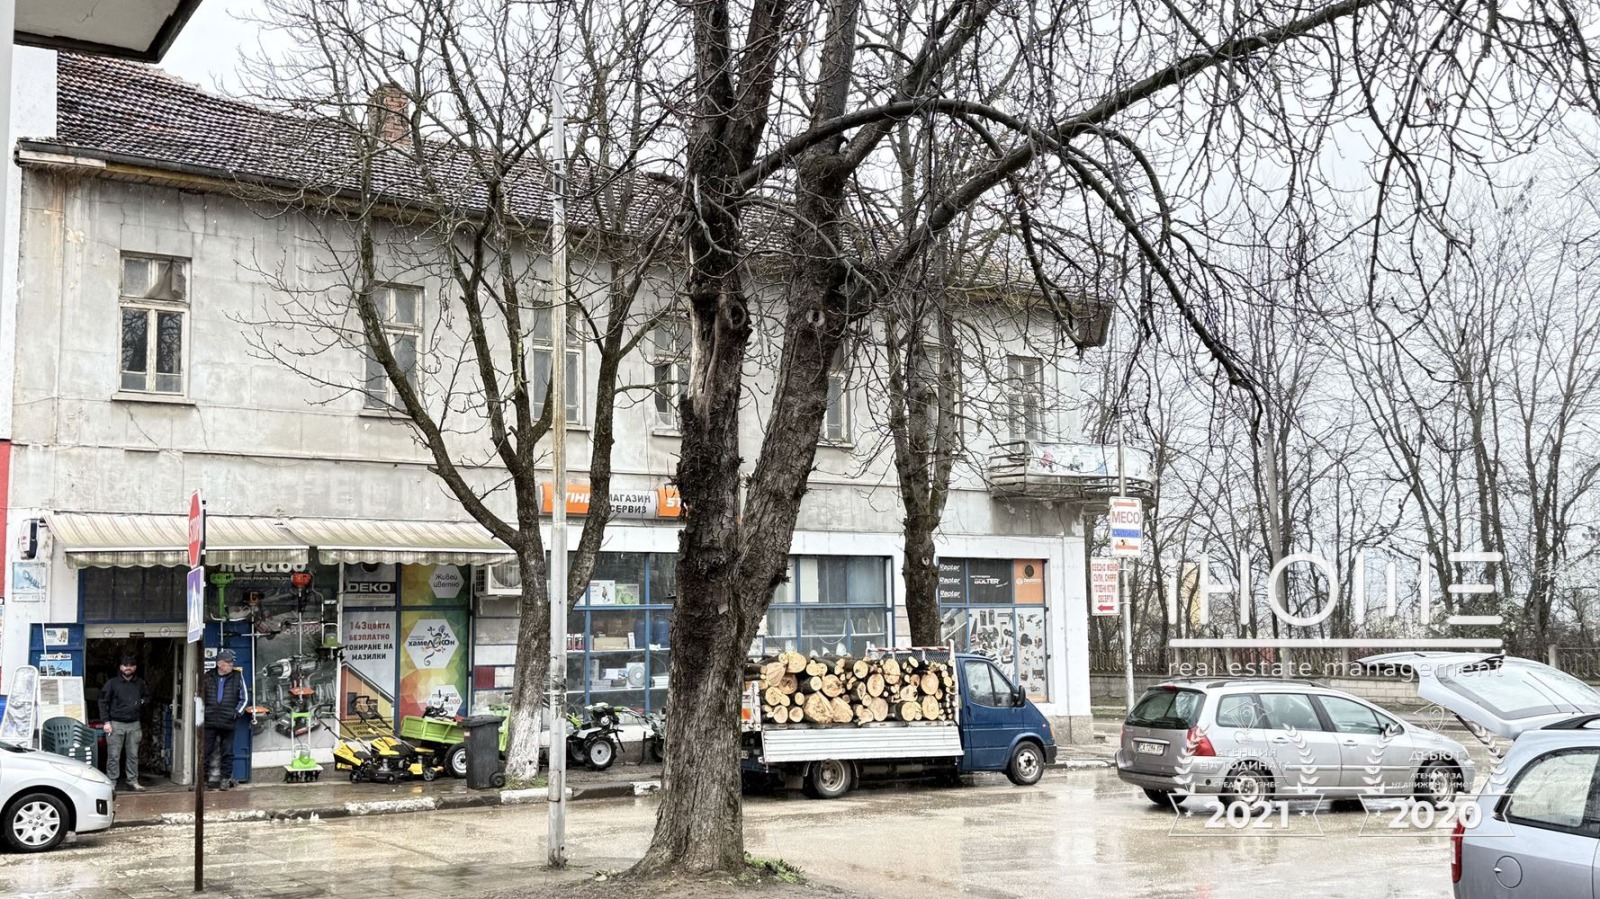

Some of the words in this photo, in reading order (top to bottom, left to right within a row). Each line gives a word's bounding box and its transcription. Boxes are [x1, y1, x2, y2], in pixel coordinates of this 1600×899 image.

[609, 504, 647, 514] СЕРВИЗ
[1111, 511, 1141, 524] МЕСО
[435, 573, 457, 581] Живей
[348, 582, 391, 593] DEKO
[349, 633, 390, 641] БЕЗПЛАТНО
[351, 653, 386, 661] МАЗИЛКИ
